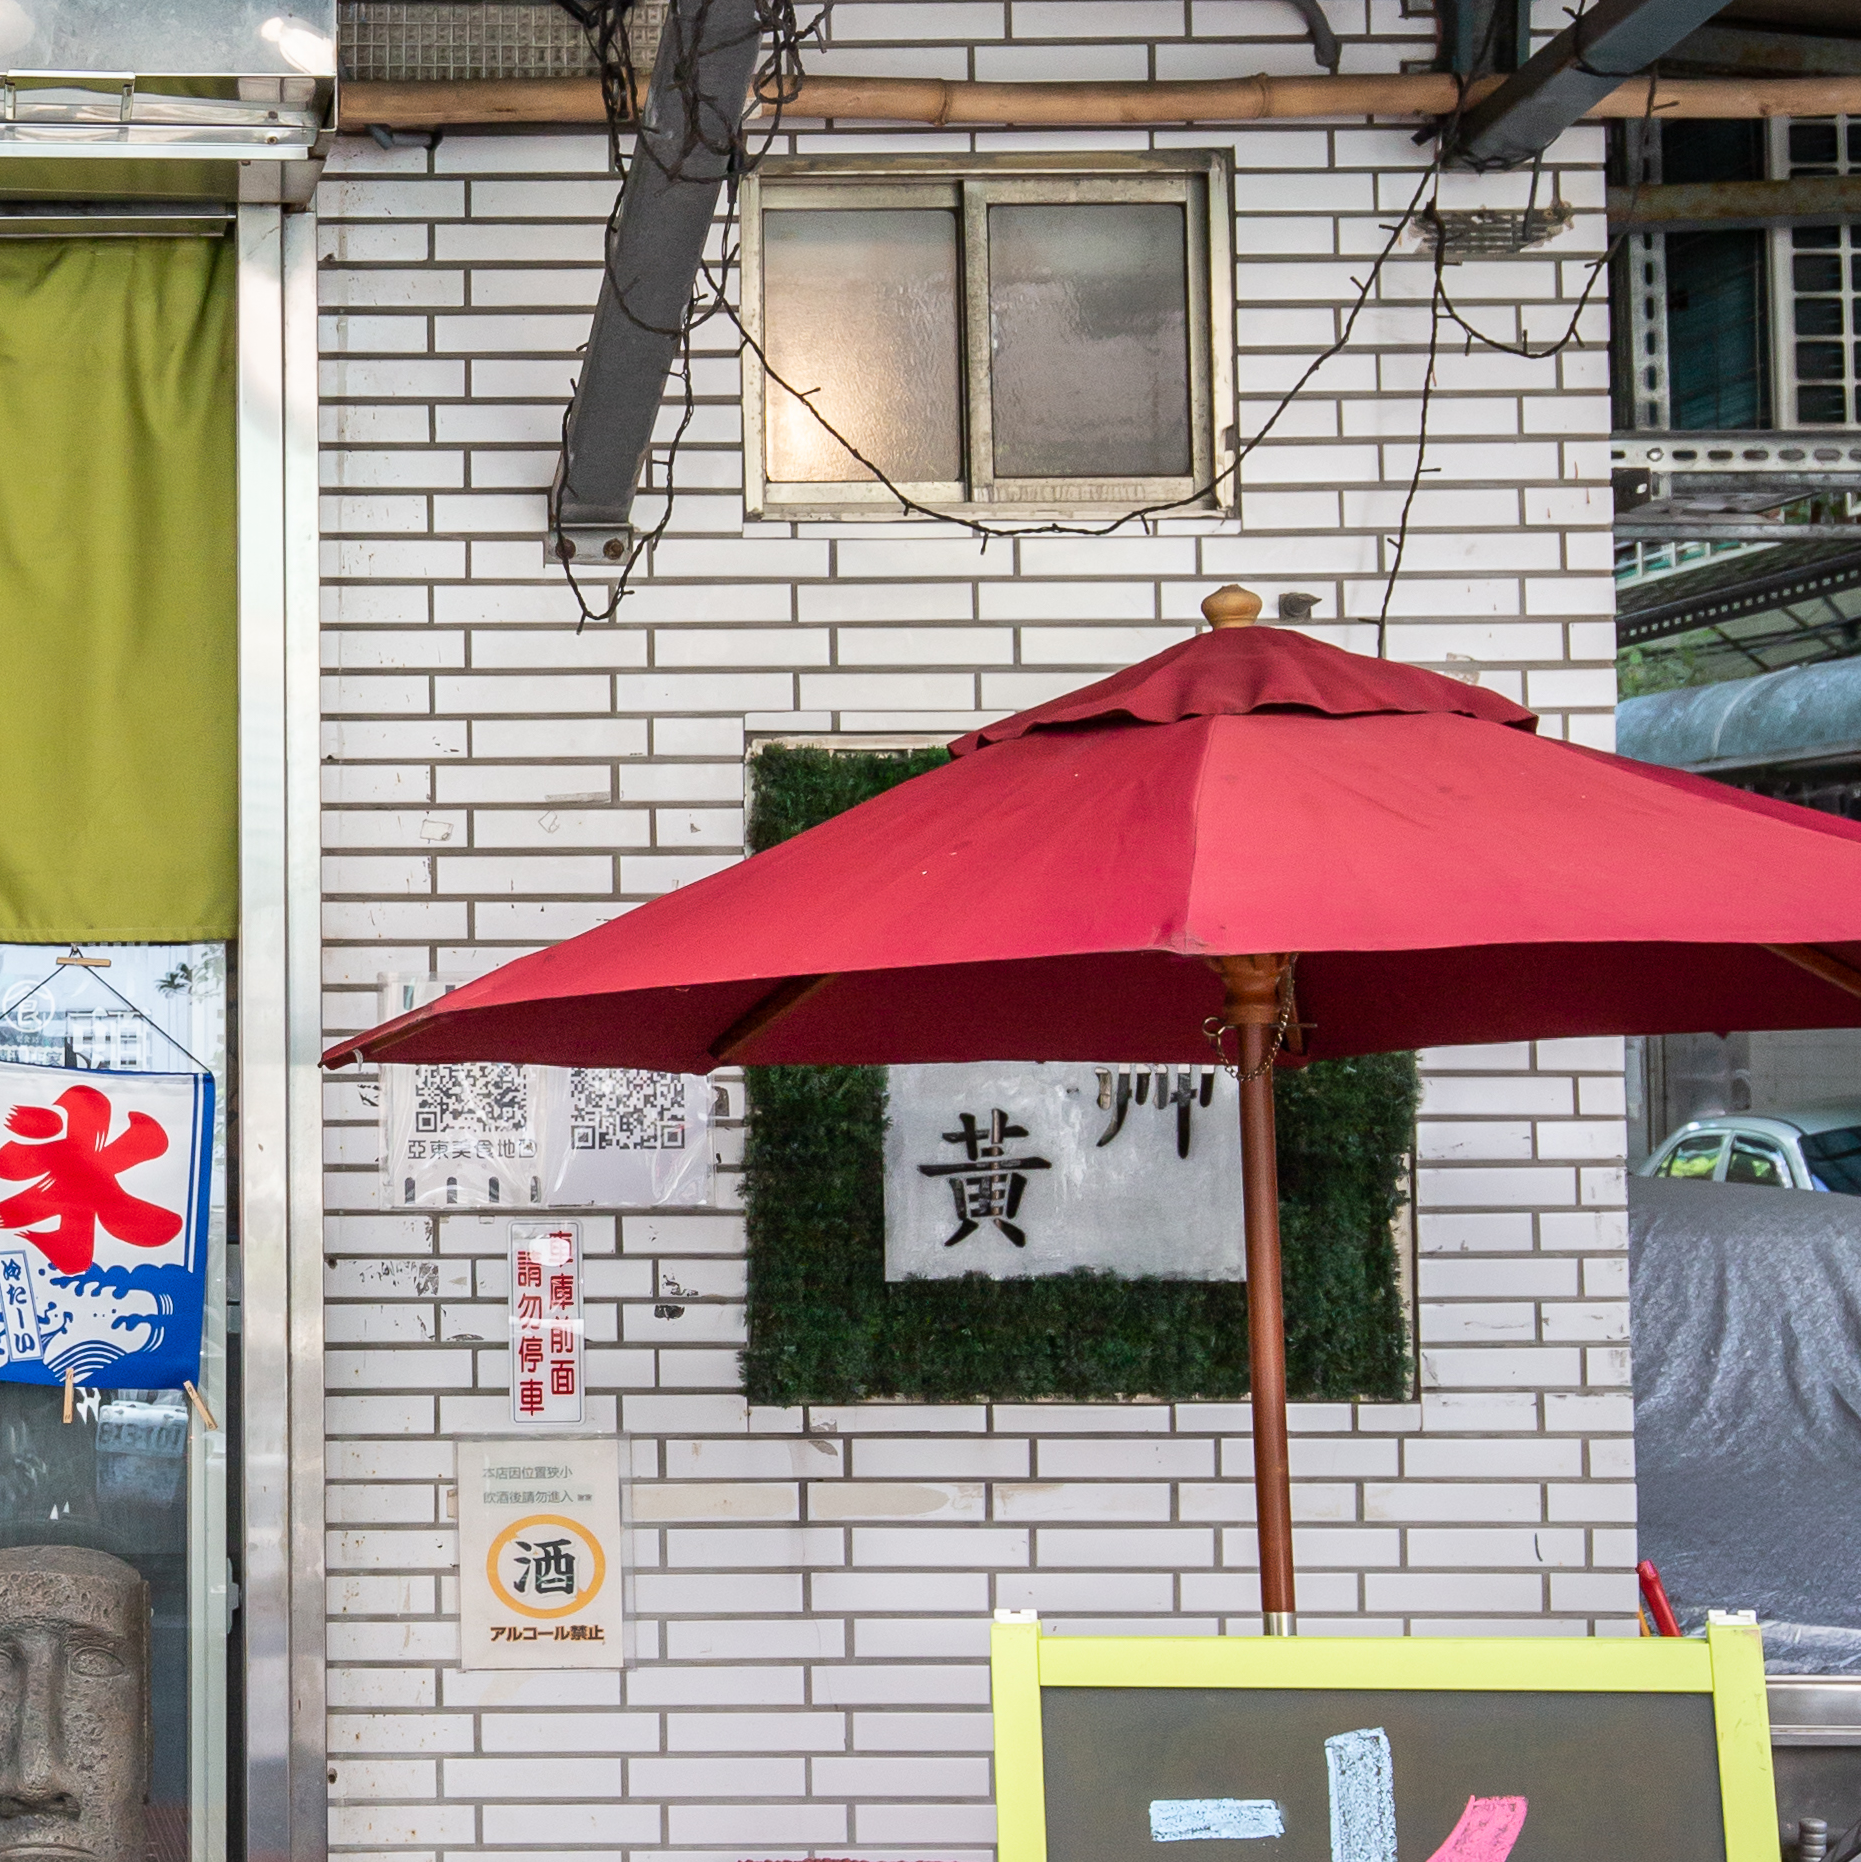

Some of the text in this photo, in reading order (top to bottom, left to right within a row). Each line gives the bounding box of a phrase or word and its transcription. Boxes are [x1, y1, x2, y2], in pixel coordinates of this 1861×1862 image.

[516, 1250, 545, 1417] 請勿停車
[513, 1538, 576, 1595] 酒
[490, 1625, 605, 1642] アルコール禁止
